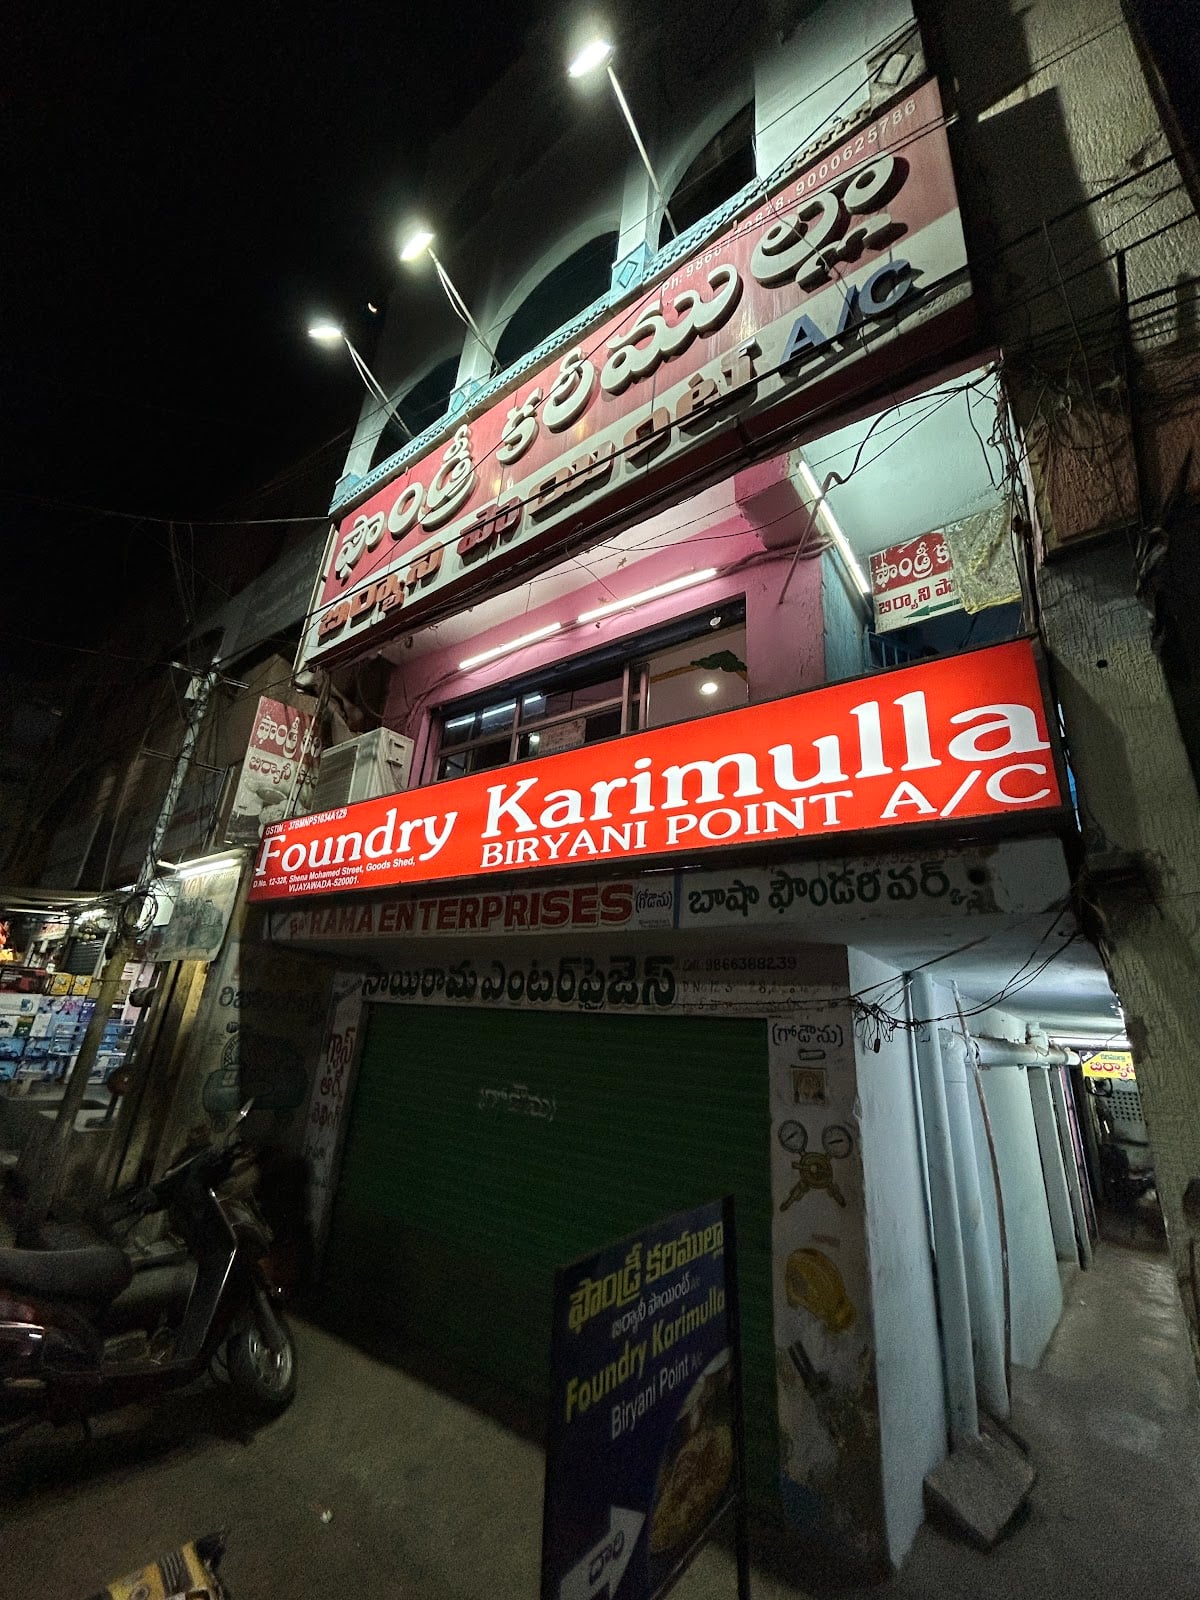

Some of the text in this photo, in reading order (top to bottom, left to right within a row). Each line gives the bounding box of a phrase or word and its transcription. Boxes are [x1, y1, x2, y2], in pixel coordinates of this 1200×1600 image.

[796, 99, 917, 195] 9000625786
[780, 259, 911, 365] A/C
[255, 690, 1051, 877] Foundry Karimulla
[479, 763, 1051, 868] BIRYANI POINT A/C
[309, 868, 341, 881] Mohamed
[341, 864, 364, 877] Street,
[365, 859, 391, 872] Goods
[392, 855, 416, 868] Shed,
[377, 883, 634, 933] ENTERPRISES
[687, 879, 760, 918] బాషా
[564, 1285, 727, 1425] Foundry Karimulla
[611, 1376, 657, 1440] Biryani
[659, 1352, 690, 1399] Point
